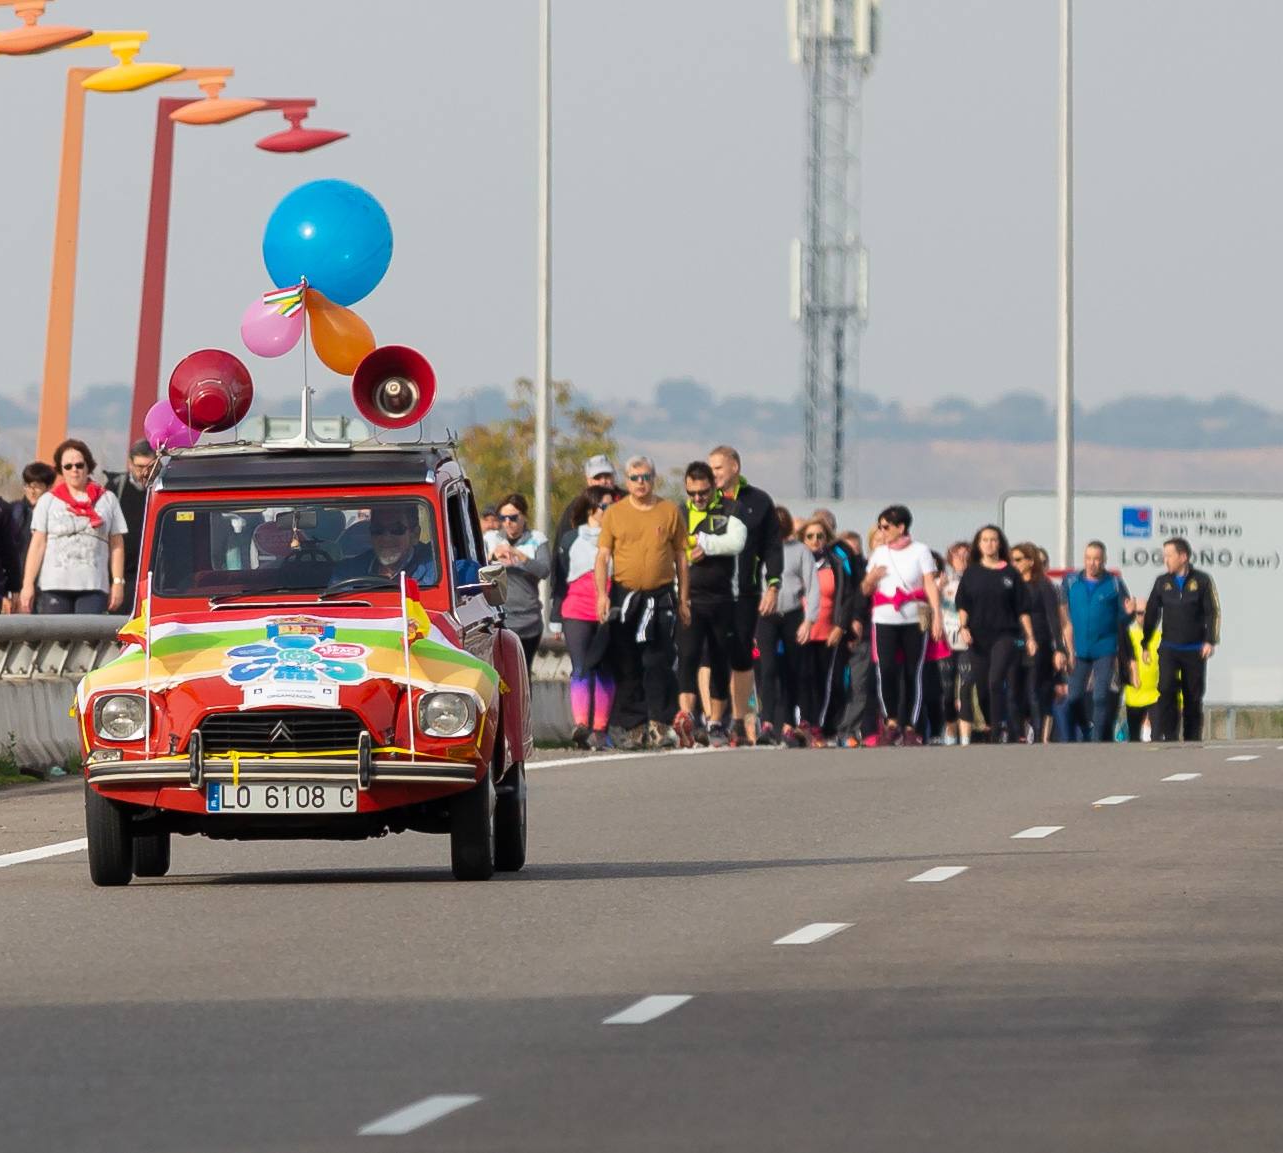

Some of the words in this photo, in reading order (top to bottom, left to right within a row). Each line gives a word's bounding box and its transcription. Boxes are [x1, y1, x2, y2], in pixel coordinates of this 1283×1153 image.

[1199, 524, 1244, 537] Pedro
[1122, 546, 1234, 566] LOGÑO
[1239, 551, 1281, 569] (sur)
[221, 785, 251, 809] LO
[265, 785, 325, 809] 6108
[339, 785, 355, 808] C
